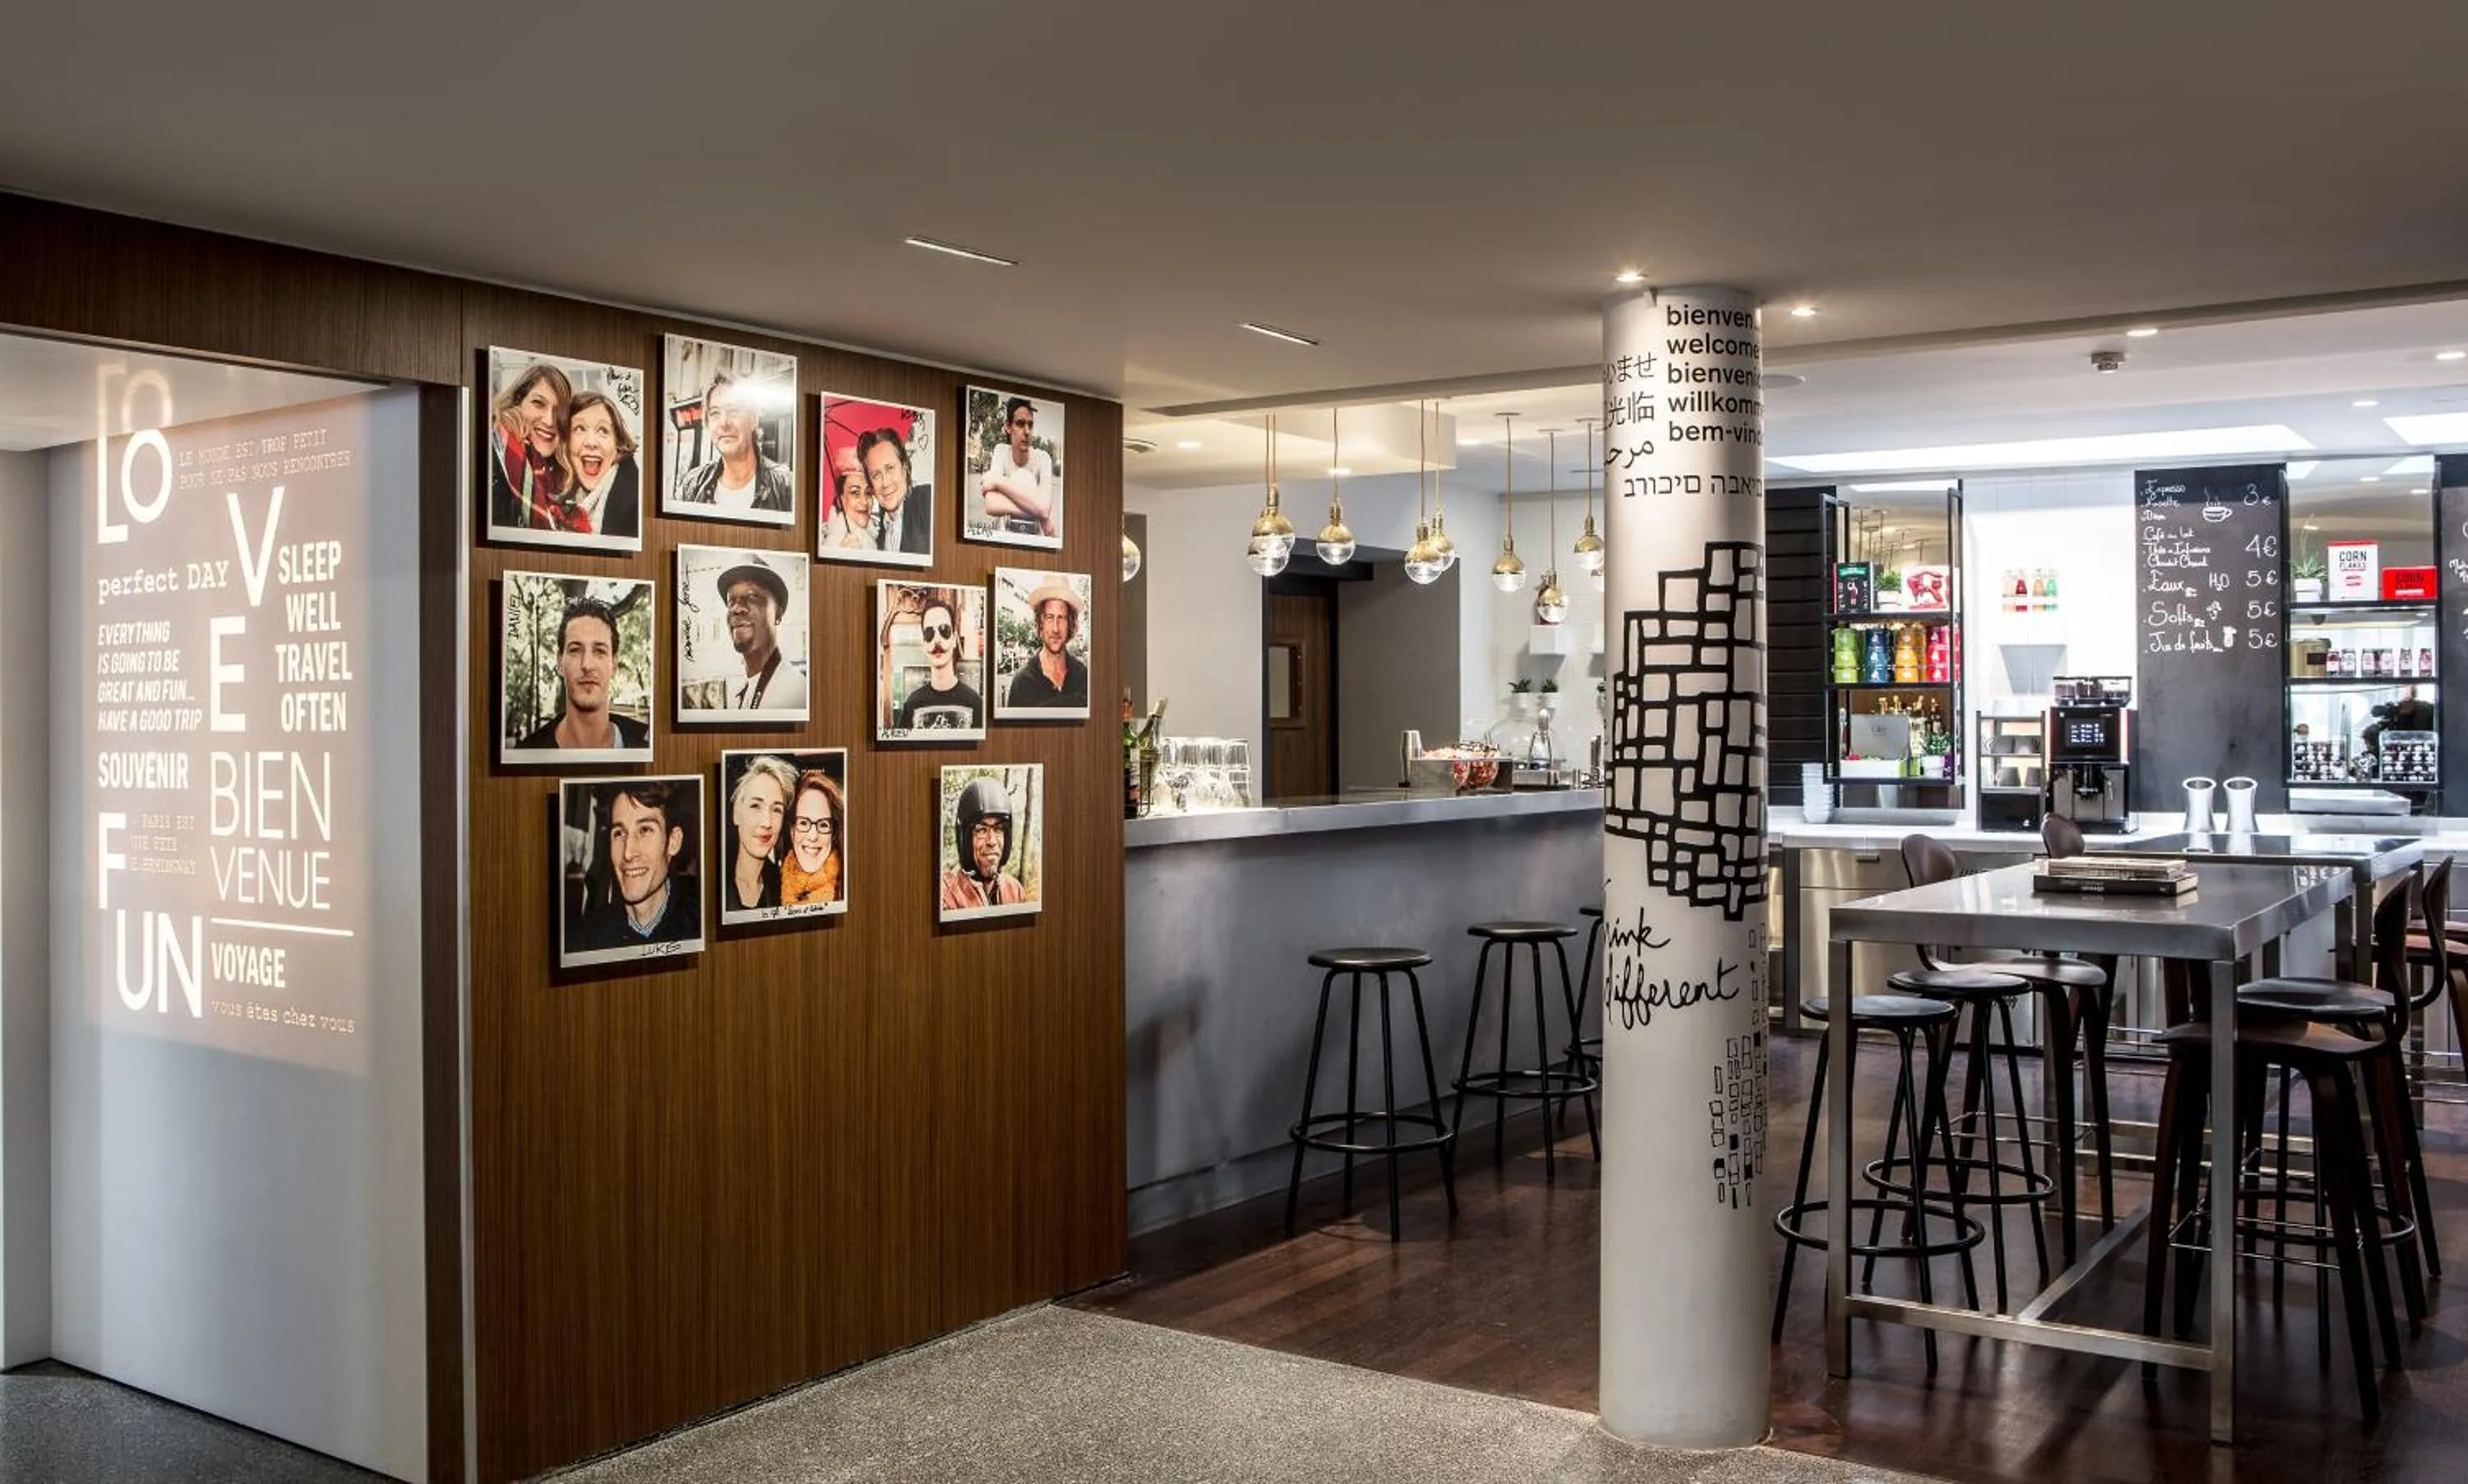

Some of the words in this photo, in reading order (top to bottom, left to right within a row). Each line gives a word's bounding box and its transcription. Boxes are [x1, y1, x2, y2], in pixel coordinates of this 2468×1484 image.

[1667, 304, 1759, 329] bienven
[1667, 332, 1760, 359] welcome
[1605, 391, 1654, 429] 光临
[236, 442, 254, 458] EST
[294, 429, 327, 449] PETIT
[278, 540, 342, 584] SLEEP
[2339, 550, 2367, 562] CORN
[98, 568, 179, 605] perfect
[187, 560, 230, 590] DAY
[285, 591, 341, 633] WELL
[98, 621, 170, 646] EVERYTHING
[98, 652, 110, 675] IS
[111, 651, 146, 675] GOING
[148, 650, 162, 672] TO
[163, 649, 180, 672] BE
[275, 641, 353, 683] TRAVEL
[98, 680, 134, 703] GREAT
[137, 679, 160, 702] AND
[98, 709, 128, 731] HAVE
[130, 710, 138, 731] A
[139, 708, 172, 732] GOOD
[174, 708, 202, 731] TRIP
[281, 692, 346, 732] OFTEN
[99, 751, 189, 789] SOUVENIR
[211, 752, 331, 842] BIEN
[176, 815, 195, 830] EST
[210, 846, 331, 909] VENUE
[211, 942, 286, 988] VOYAGE
[211, 1000, 243, 1017] vous
[246, 1000, 277, 1023] êtes
[282, 1006, 315, 1028] chez
[320, 1015, 356, 1035] vous
